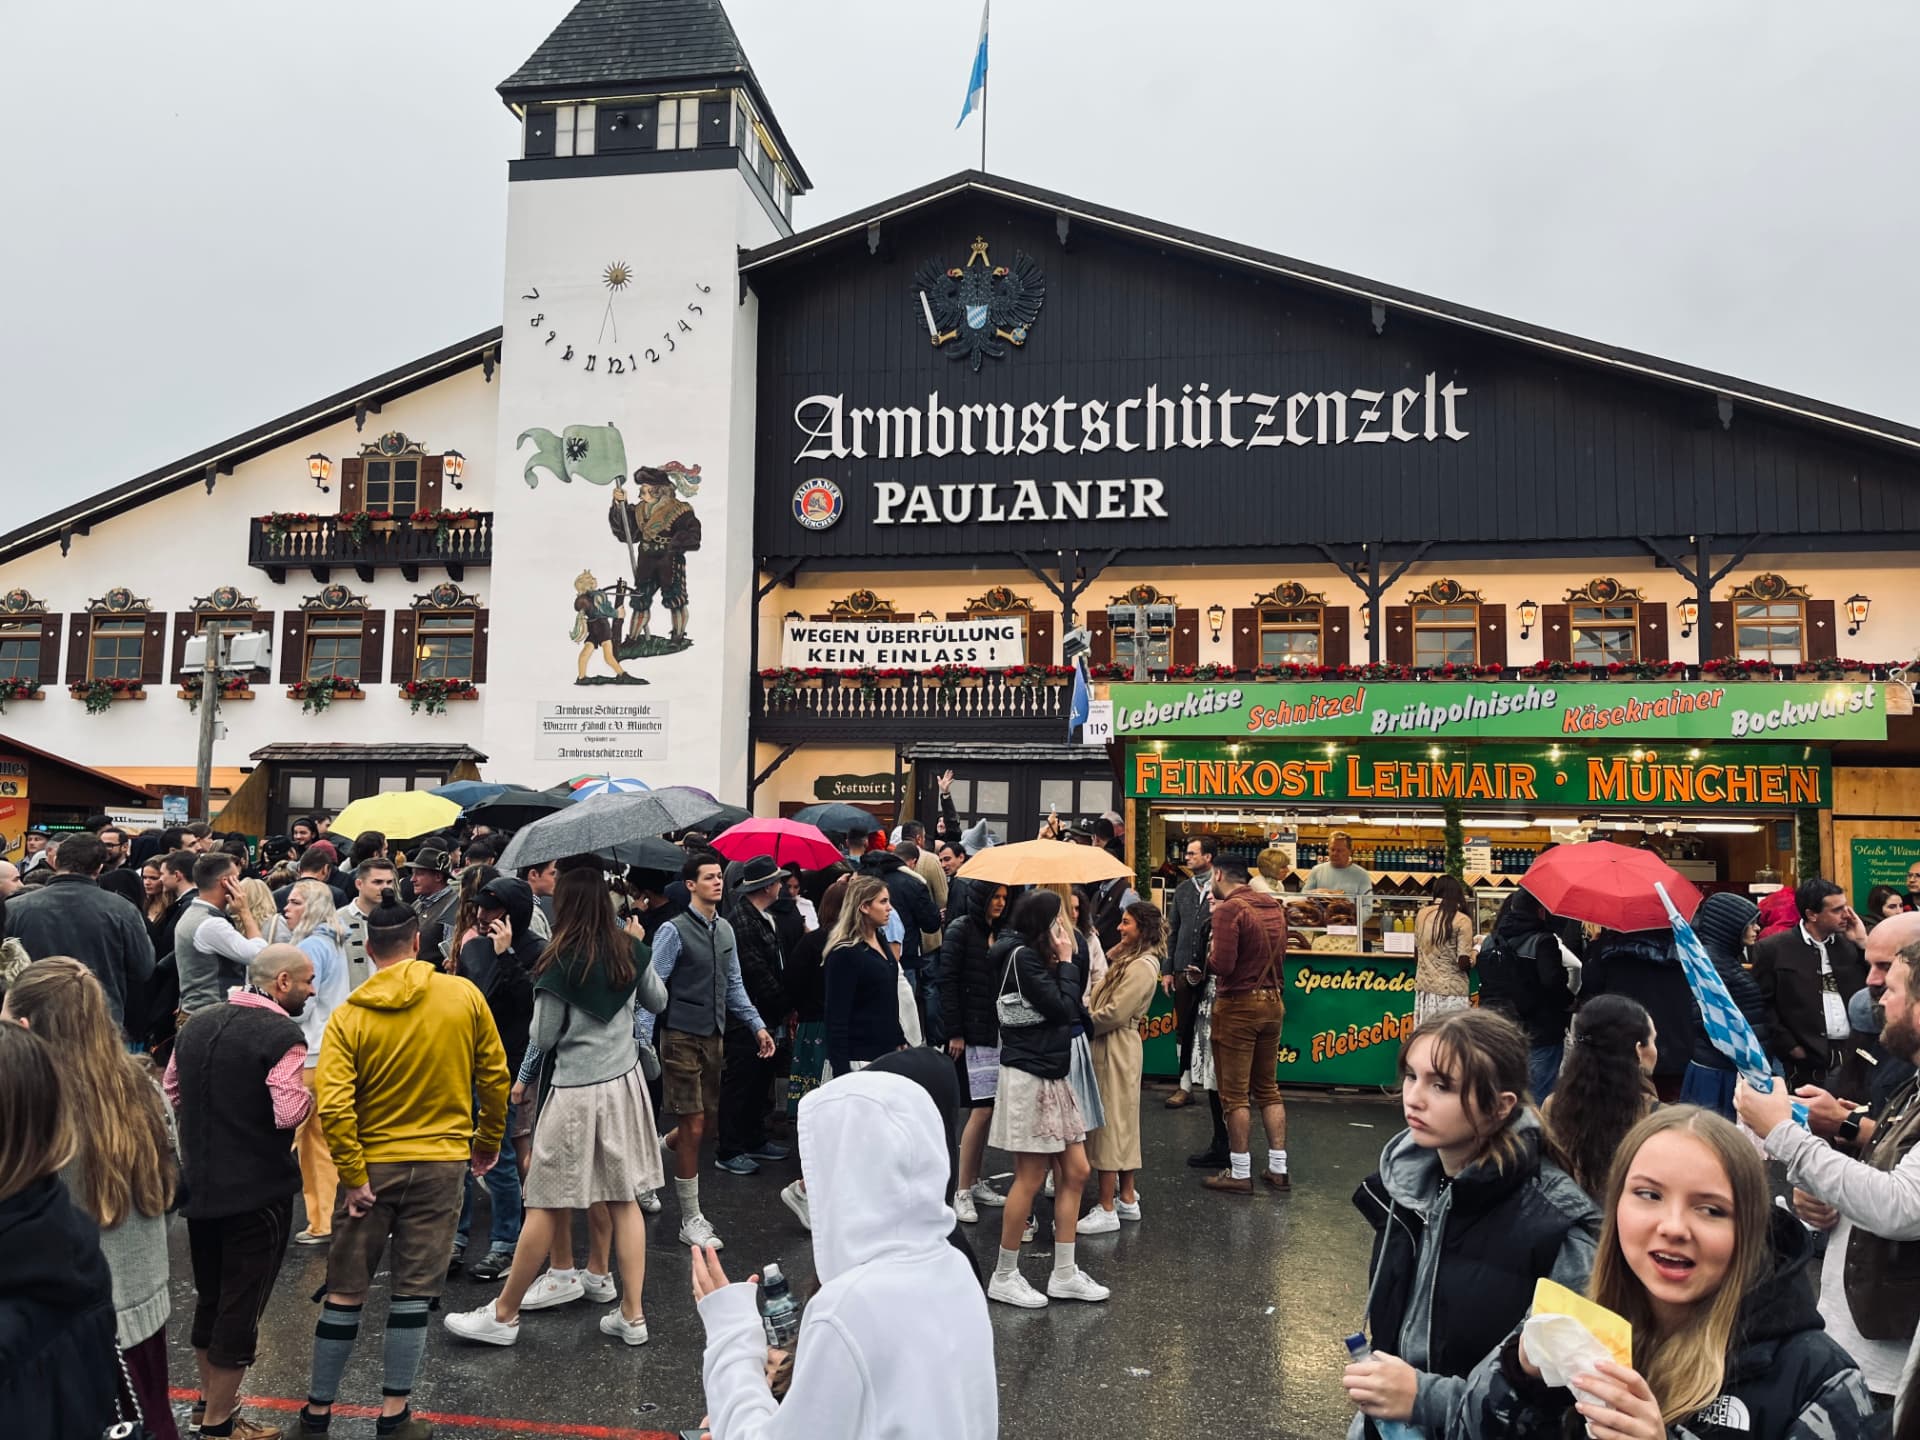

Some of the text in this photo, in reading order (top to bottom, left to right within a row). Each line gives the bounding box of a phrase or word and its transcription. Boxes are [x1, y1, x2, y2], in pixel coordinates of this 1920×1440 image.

[531, 313, 544, 327] 8
[545, 331, 556, 346] 9
[607, 356, 625, 374] 12
[629, 354, 637, 371] 1
[645, 348, 660, 363] 2
[664, 333, 675, 352] 3
[677, 319, 692, 334] 4
[688, 303, 703, 315] 5
[696, 283, 711, 294] 6
[793, 371, 1470, 464] Armbrustschützenzelt
[794, 480, 840, 501] PAULANER
[873, 478, 1169, 525] PAULANER
[791, 626, 1015, 644] WEGEN ÜBERFÜLLUNG
[808, 648, 865, 662] KEIN
[878, 647, 977, 663] EINLASS
[1116, 684, 1876, 737] Leberkäse Schnitzel Brühpolnische Käsekrainer Bockwurst
[1089, 723, 1108, 735] 119
[833, 781, 887, 796] Festwirt
[1135, 750, 1821, 804] FEINKOST LEHMAIR MÜNCHEN
[1295, 968, 1416, 995] Speckflade
[1311, 1012, 1415, 1062] Fleischp
[1697, 1411, 1728, 1426] FACE
